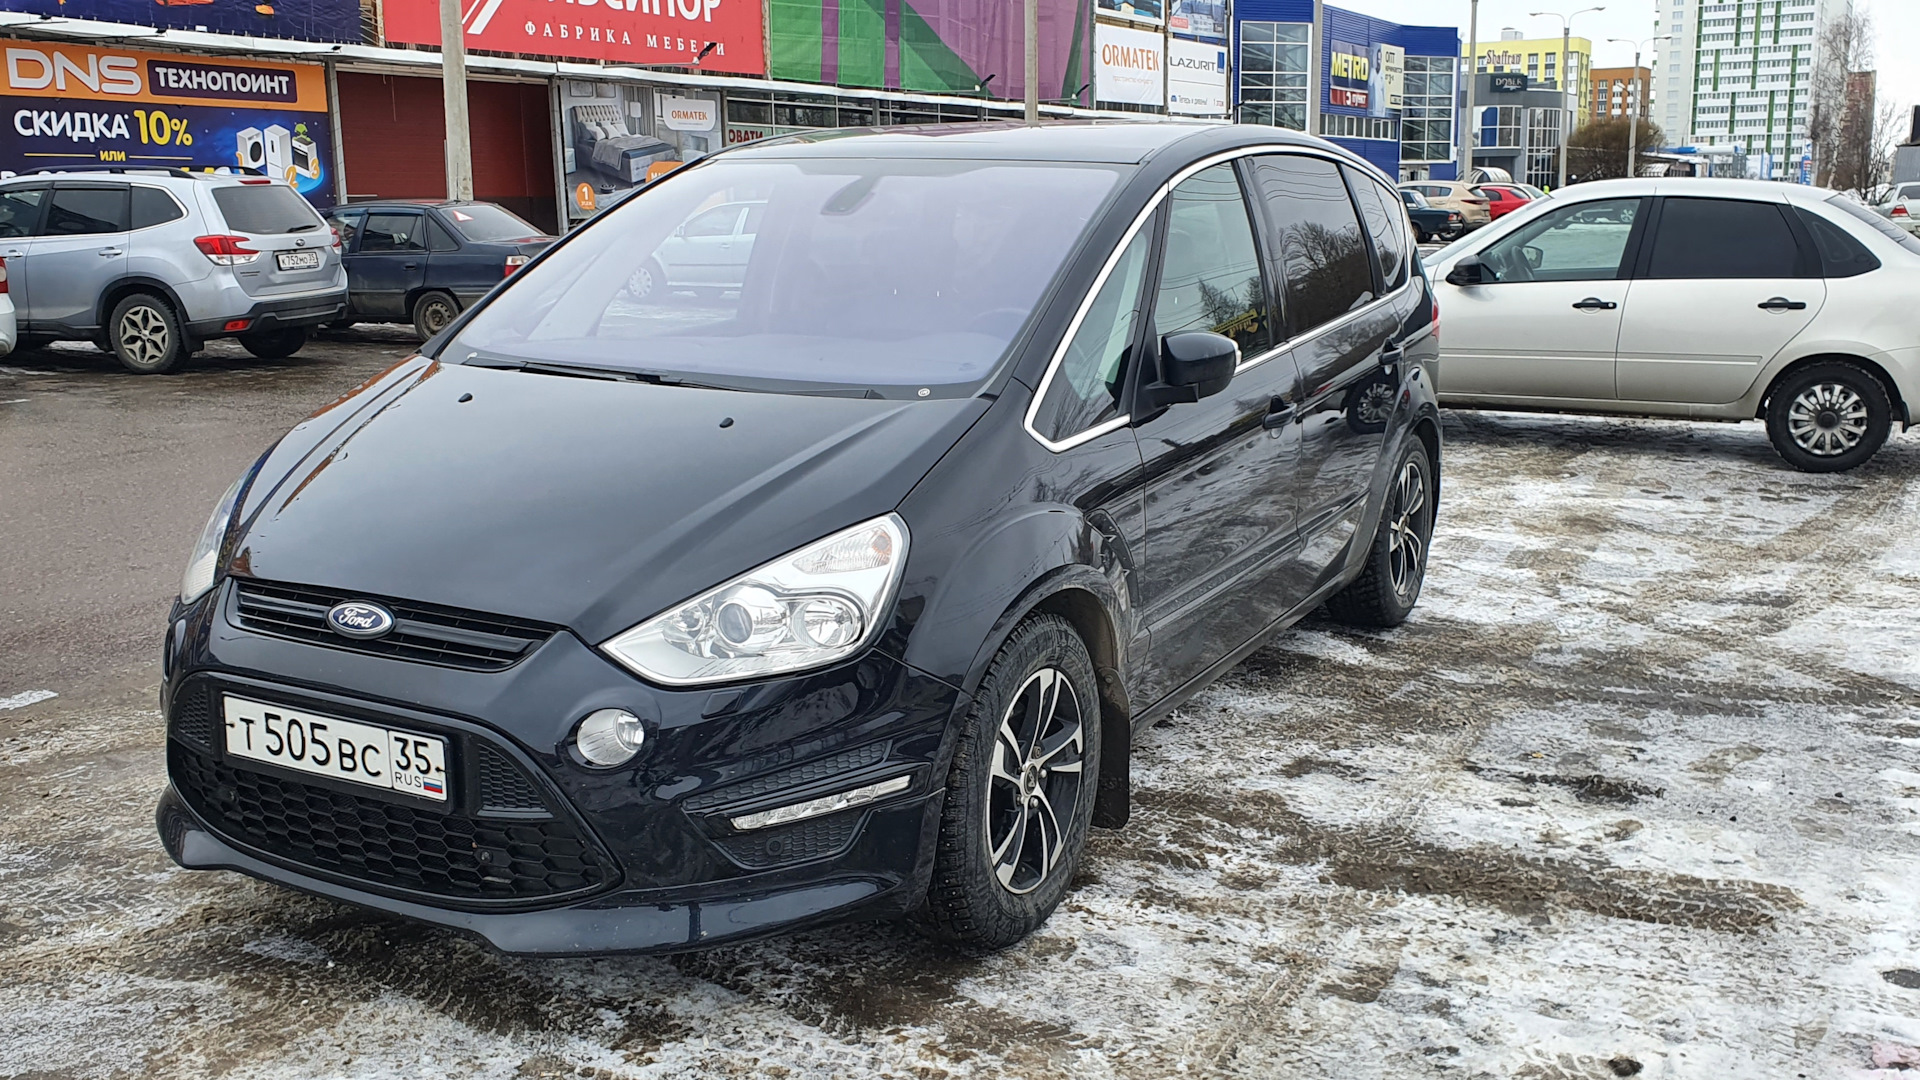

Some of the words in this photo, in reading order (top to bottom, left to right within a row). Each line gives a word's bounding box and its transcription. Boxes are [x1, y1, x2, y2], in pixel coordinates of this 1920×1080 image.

[524, 21, 632, 46] ФАБРИКА
[1102, 44, 1160, 71] ORMATEK
[1170, 56, 1216, 71] LAZURIT
[1331, 51, 1369, 81] METRO
[6, 48, 142, 95] DNS
[155, 67, 289, 95] ТЕХНОПОИНТ
[671, 110, 708, 120] ORMATEK
[134, 110, 193, 146] 10%
[100, 150, 126, 161] ИЛИ
[286, 165, 299, 189] 2
[311, 157, 320, 180] 3
[582, 186, 589, 201] 1
[338, 606, 377, 629] Ford
[394, 736, 432, 776] 35
[395, 772, 422, 788] RUS
